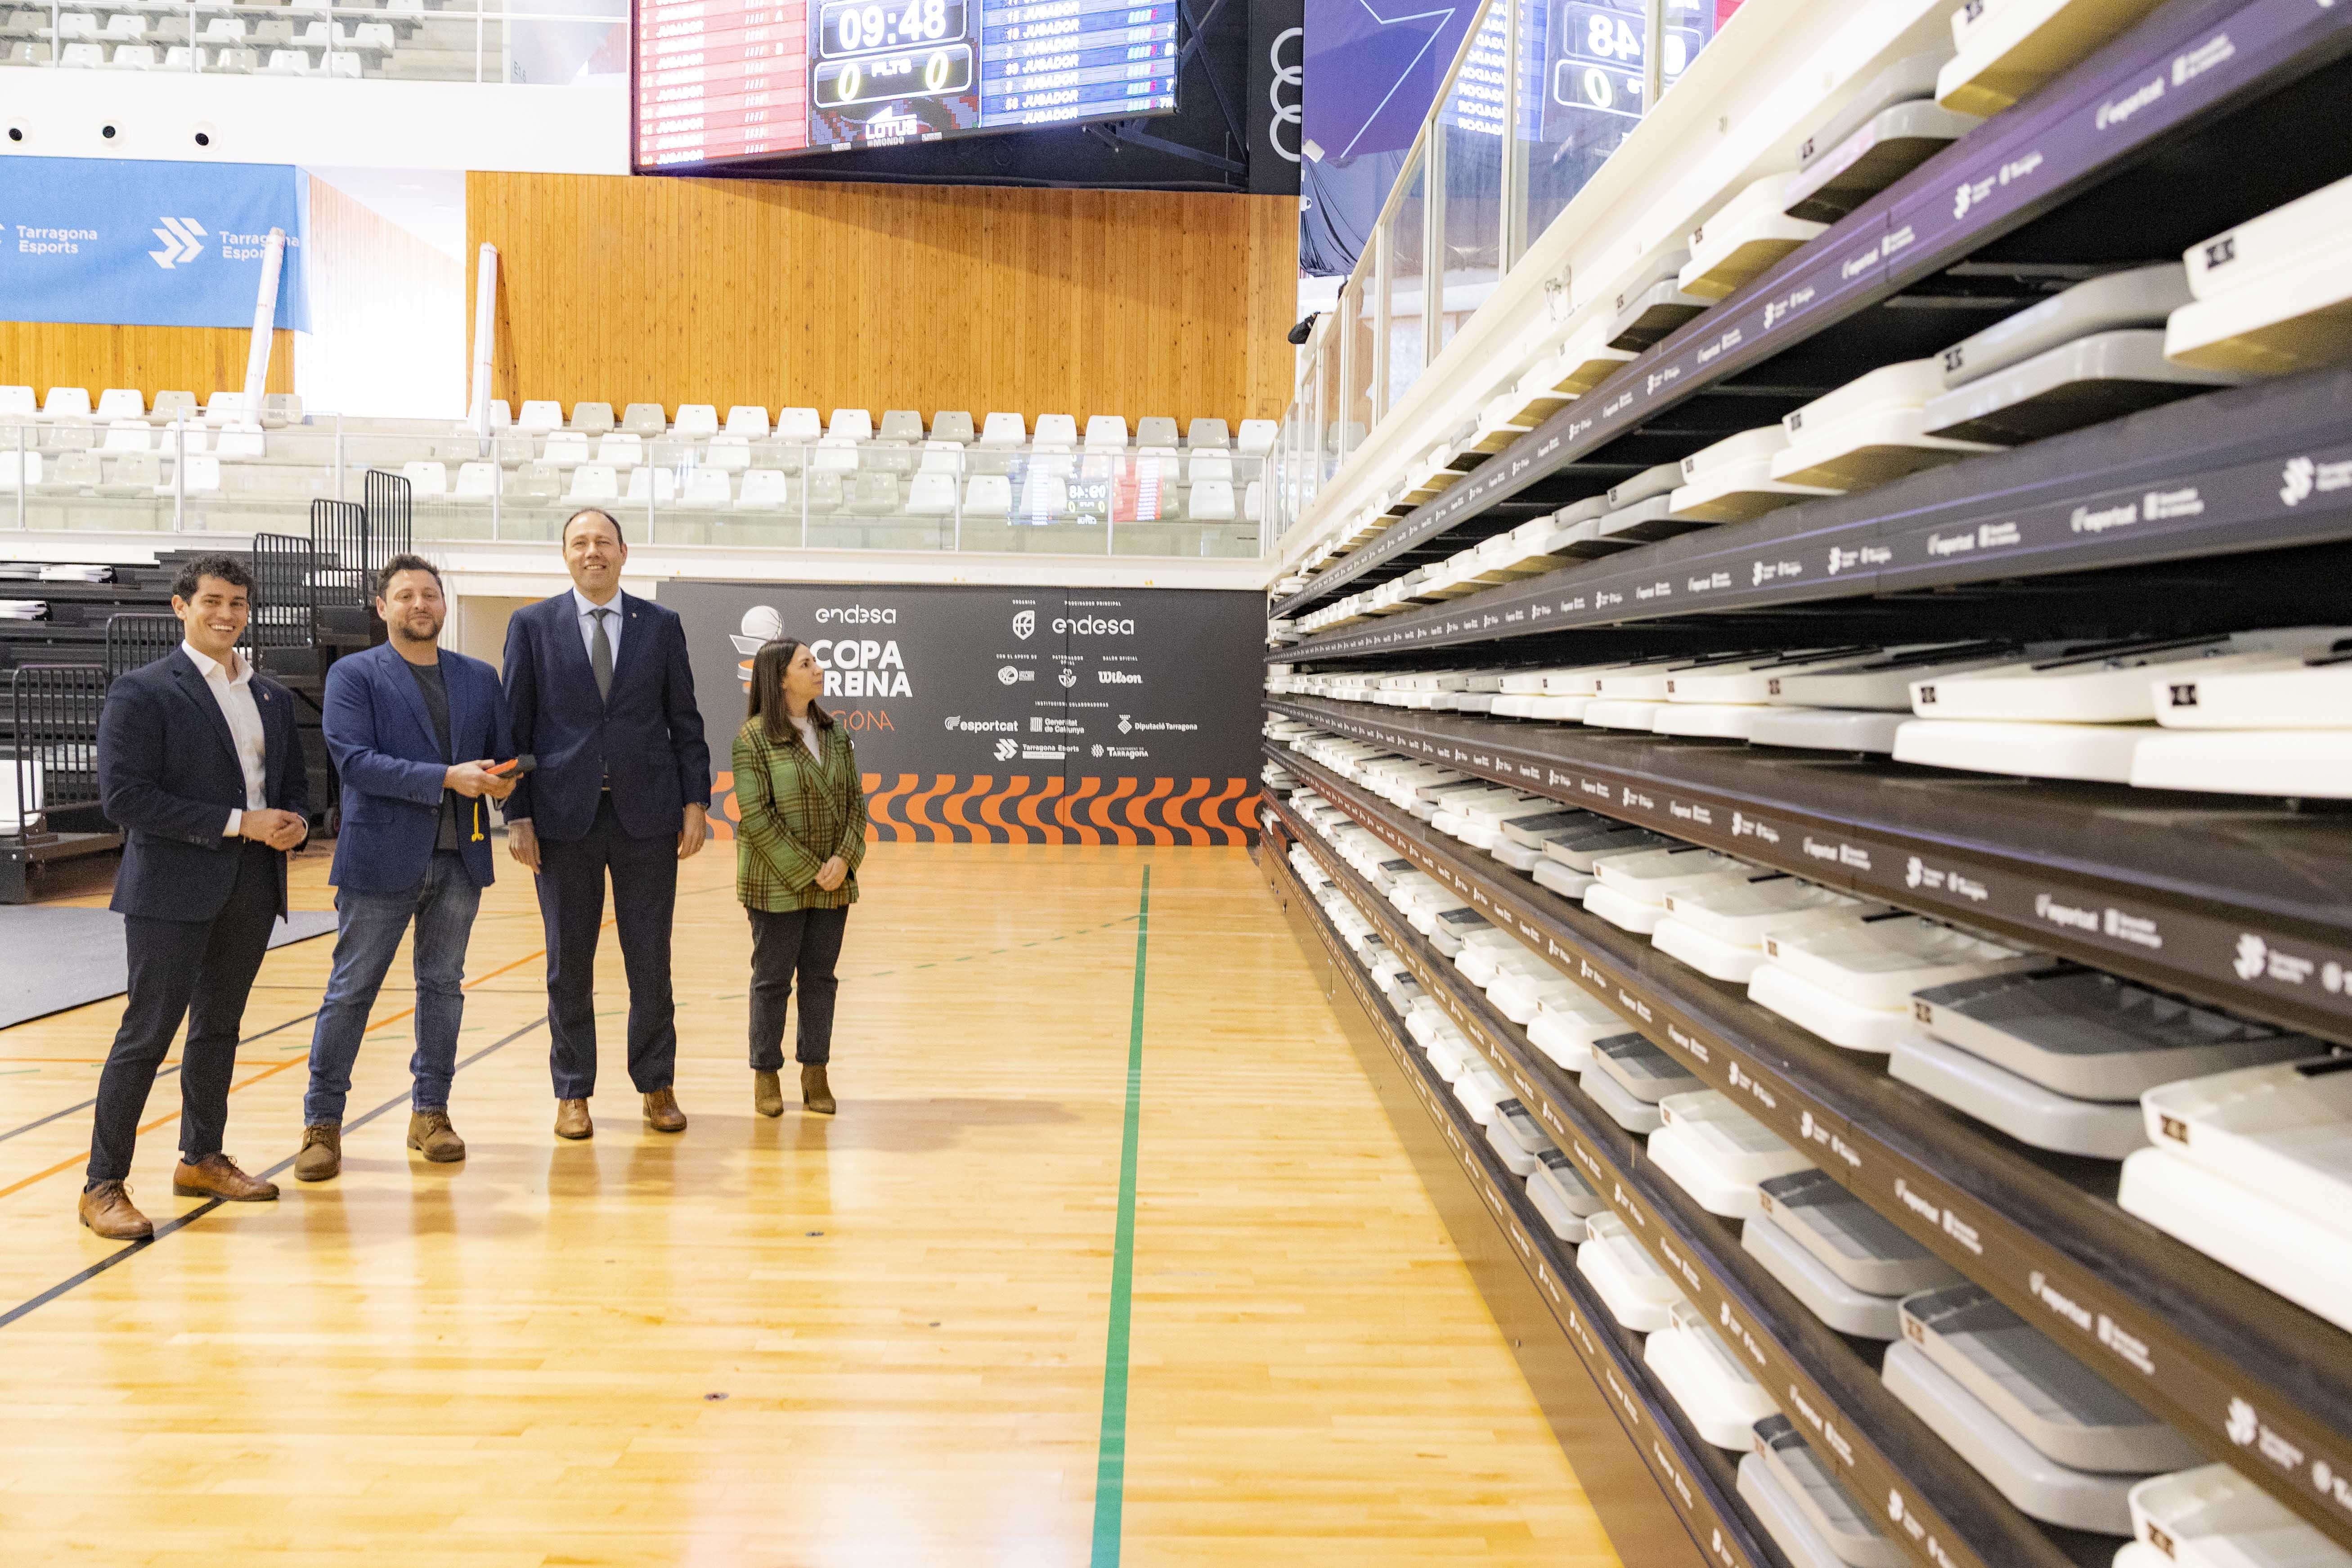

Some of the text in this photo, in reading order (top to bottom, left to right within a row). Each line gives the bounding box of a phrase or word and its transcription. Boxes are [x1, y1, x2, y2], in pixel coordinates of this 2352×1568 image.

[839, 0, 946, 50] 09:48
[838, 63, 861, 101] 0
[925, 51, 948, 90] 0
[865, 119, 917, 140] LOTUS
[16, 225, 97, 241] Tarragona
[219, 231, 299, 248] Tarragna
[19, 239, 79, 255] Esports
[222, 247, 265, 261] Espor
[815, 604, 897, 624] endesa
[1052, 615, 1134, 635] endesa
[809, 639, 904, 669] COPA
[823, 670, 913, 697] RENA
[1098, 670, 1142, 683] Wilson
[960, 720, 1018, 733] esportcat
[1135, 723, 1198, 732] Diputació Tarragona
